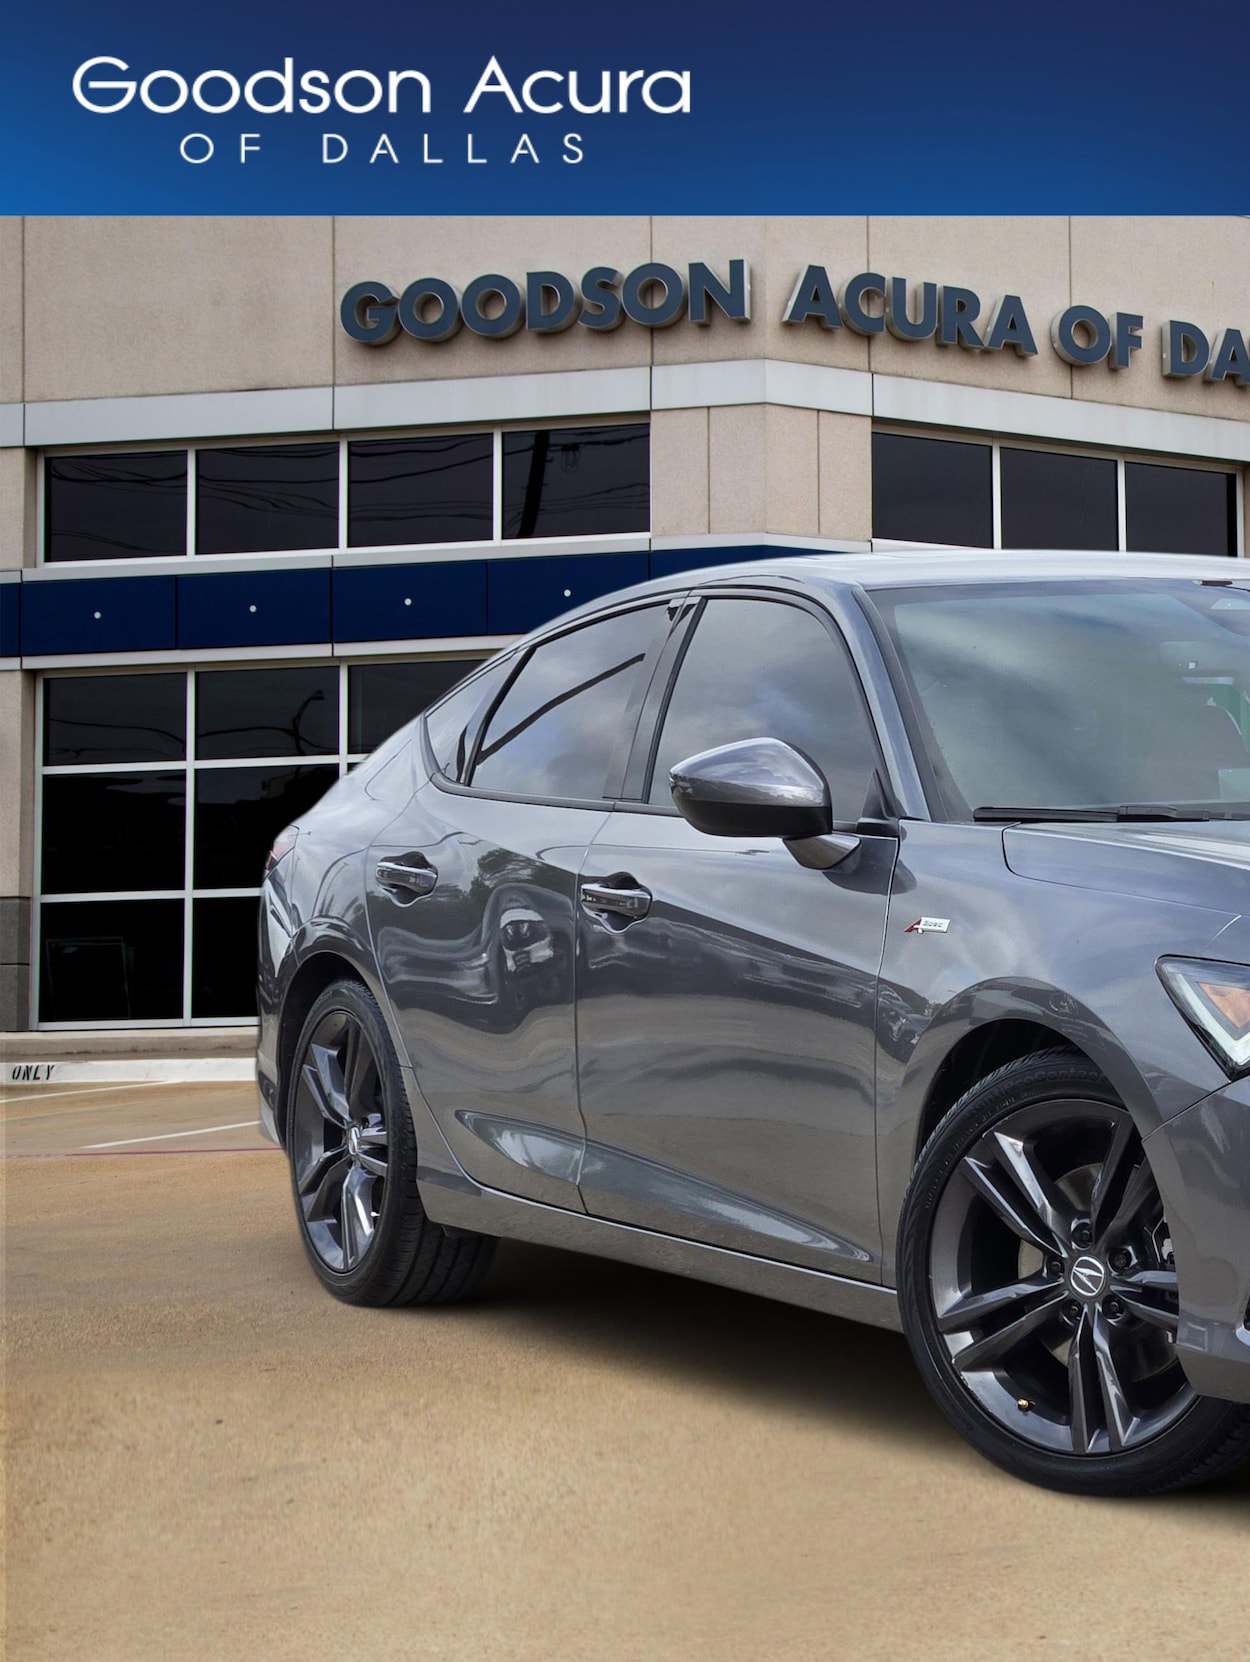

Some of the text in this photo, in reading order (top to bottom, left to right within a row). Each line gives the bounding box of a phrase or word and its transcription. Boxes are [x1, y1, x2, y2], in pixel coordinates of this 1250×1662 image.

[340, 259, 751, 347] GOODSON
[784, 265, 1038, 357] ACURA
[1050, 304, 1143, 369] OF
[12, 1064, 55, 1080] ONLY
